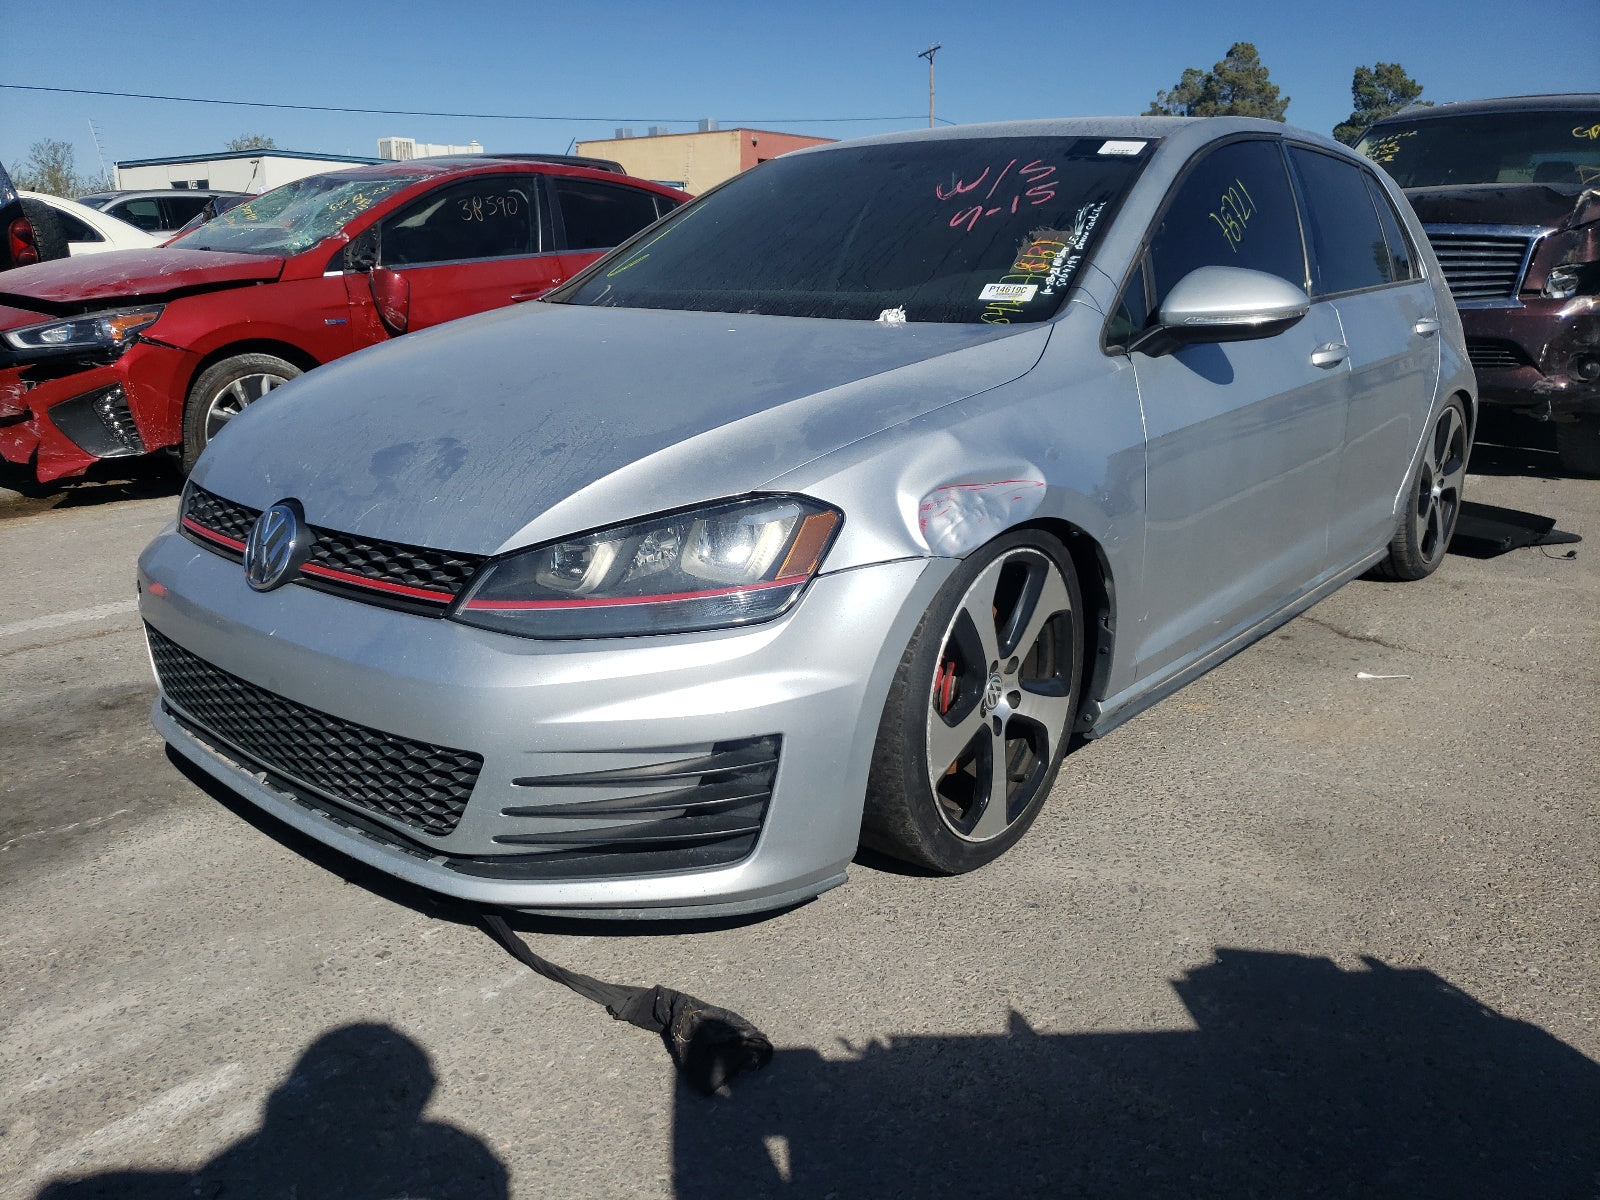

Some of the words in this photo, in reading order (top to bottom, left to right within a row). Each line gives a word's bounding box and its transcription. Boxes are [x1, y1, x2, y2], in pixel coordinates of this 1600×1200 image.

[457, 194, 518, 222] 38590
[949, 181, 1060, 231] 9-15
[988, 285, 1028, 294] P14619C
